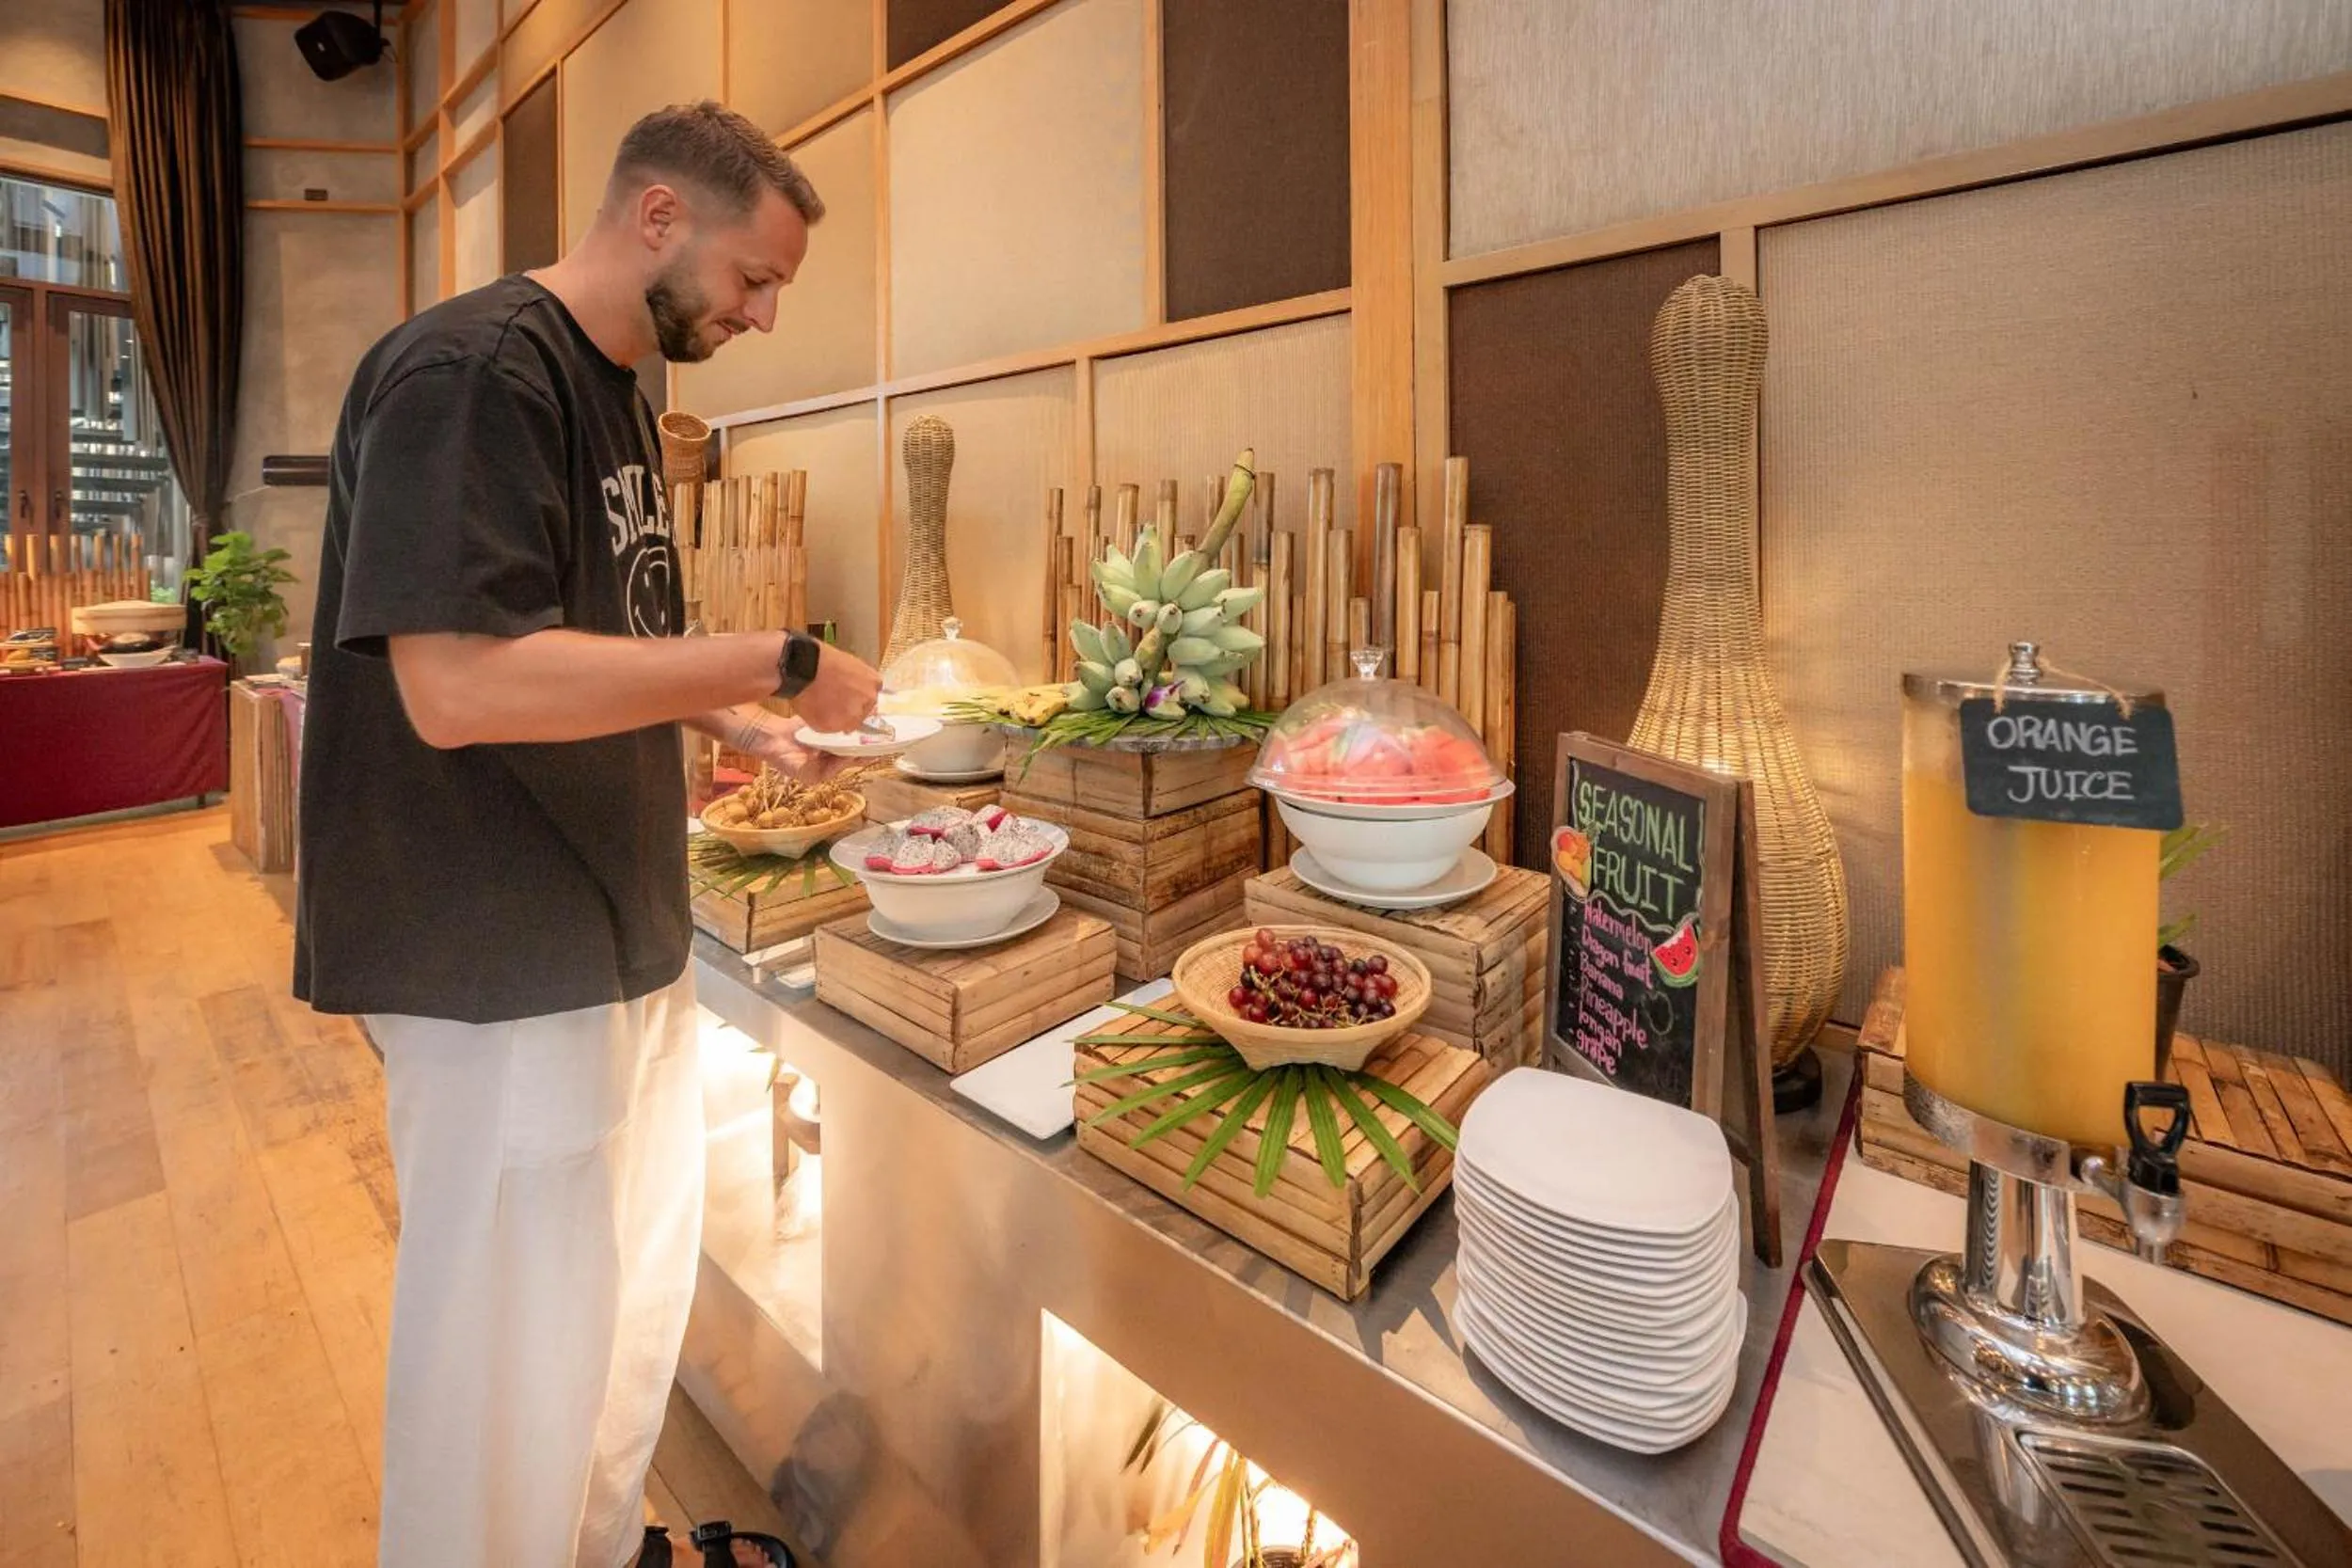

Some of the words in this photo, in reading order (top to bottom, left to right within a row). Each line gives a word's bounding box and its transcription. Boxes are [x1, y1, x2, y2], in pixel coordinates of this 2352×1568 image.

[602, 465, 671, 557] SMLE
[1987, 715, 2138, 757] ORANGE
[2006, 765, 2136, 802] JUICE
[1578, 780, 1694, 873] SEASONAL
[1593, 847, 1685, 920] FRUIT
[1581, 951, 1624, 1001] Banana
[1581, 974, 1648, 1050] Pineapple
